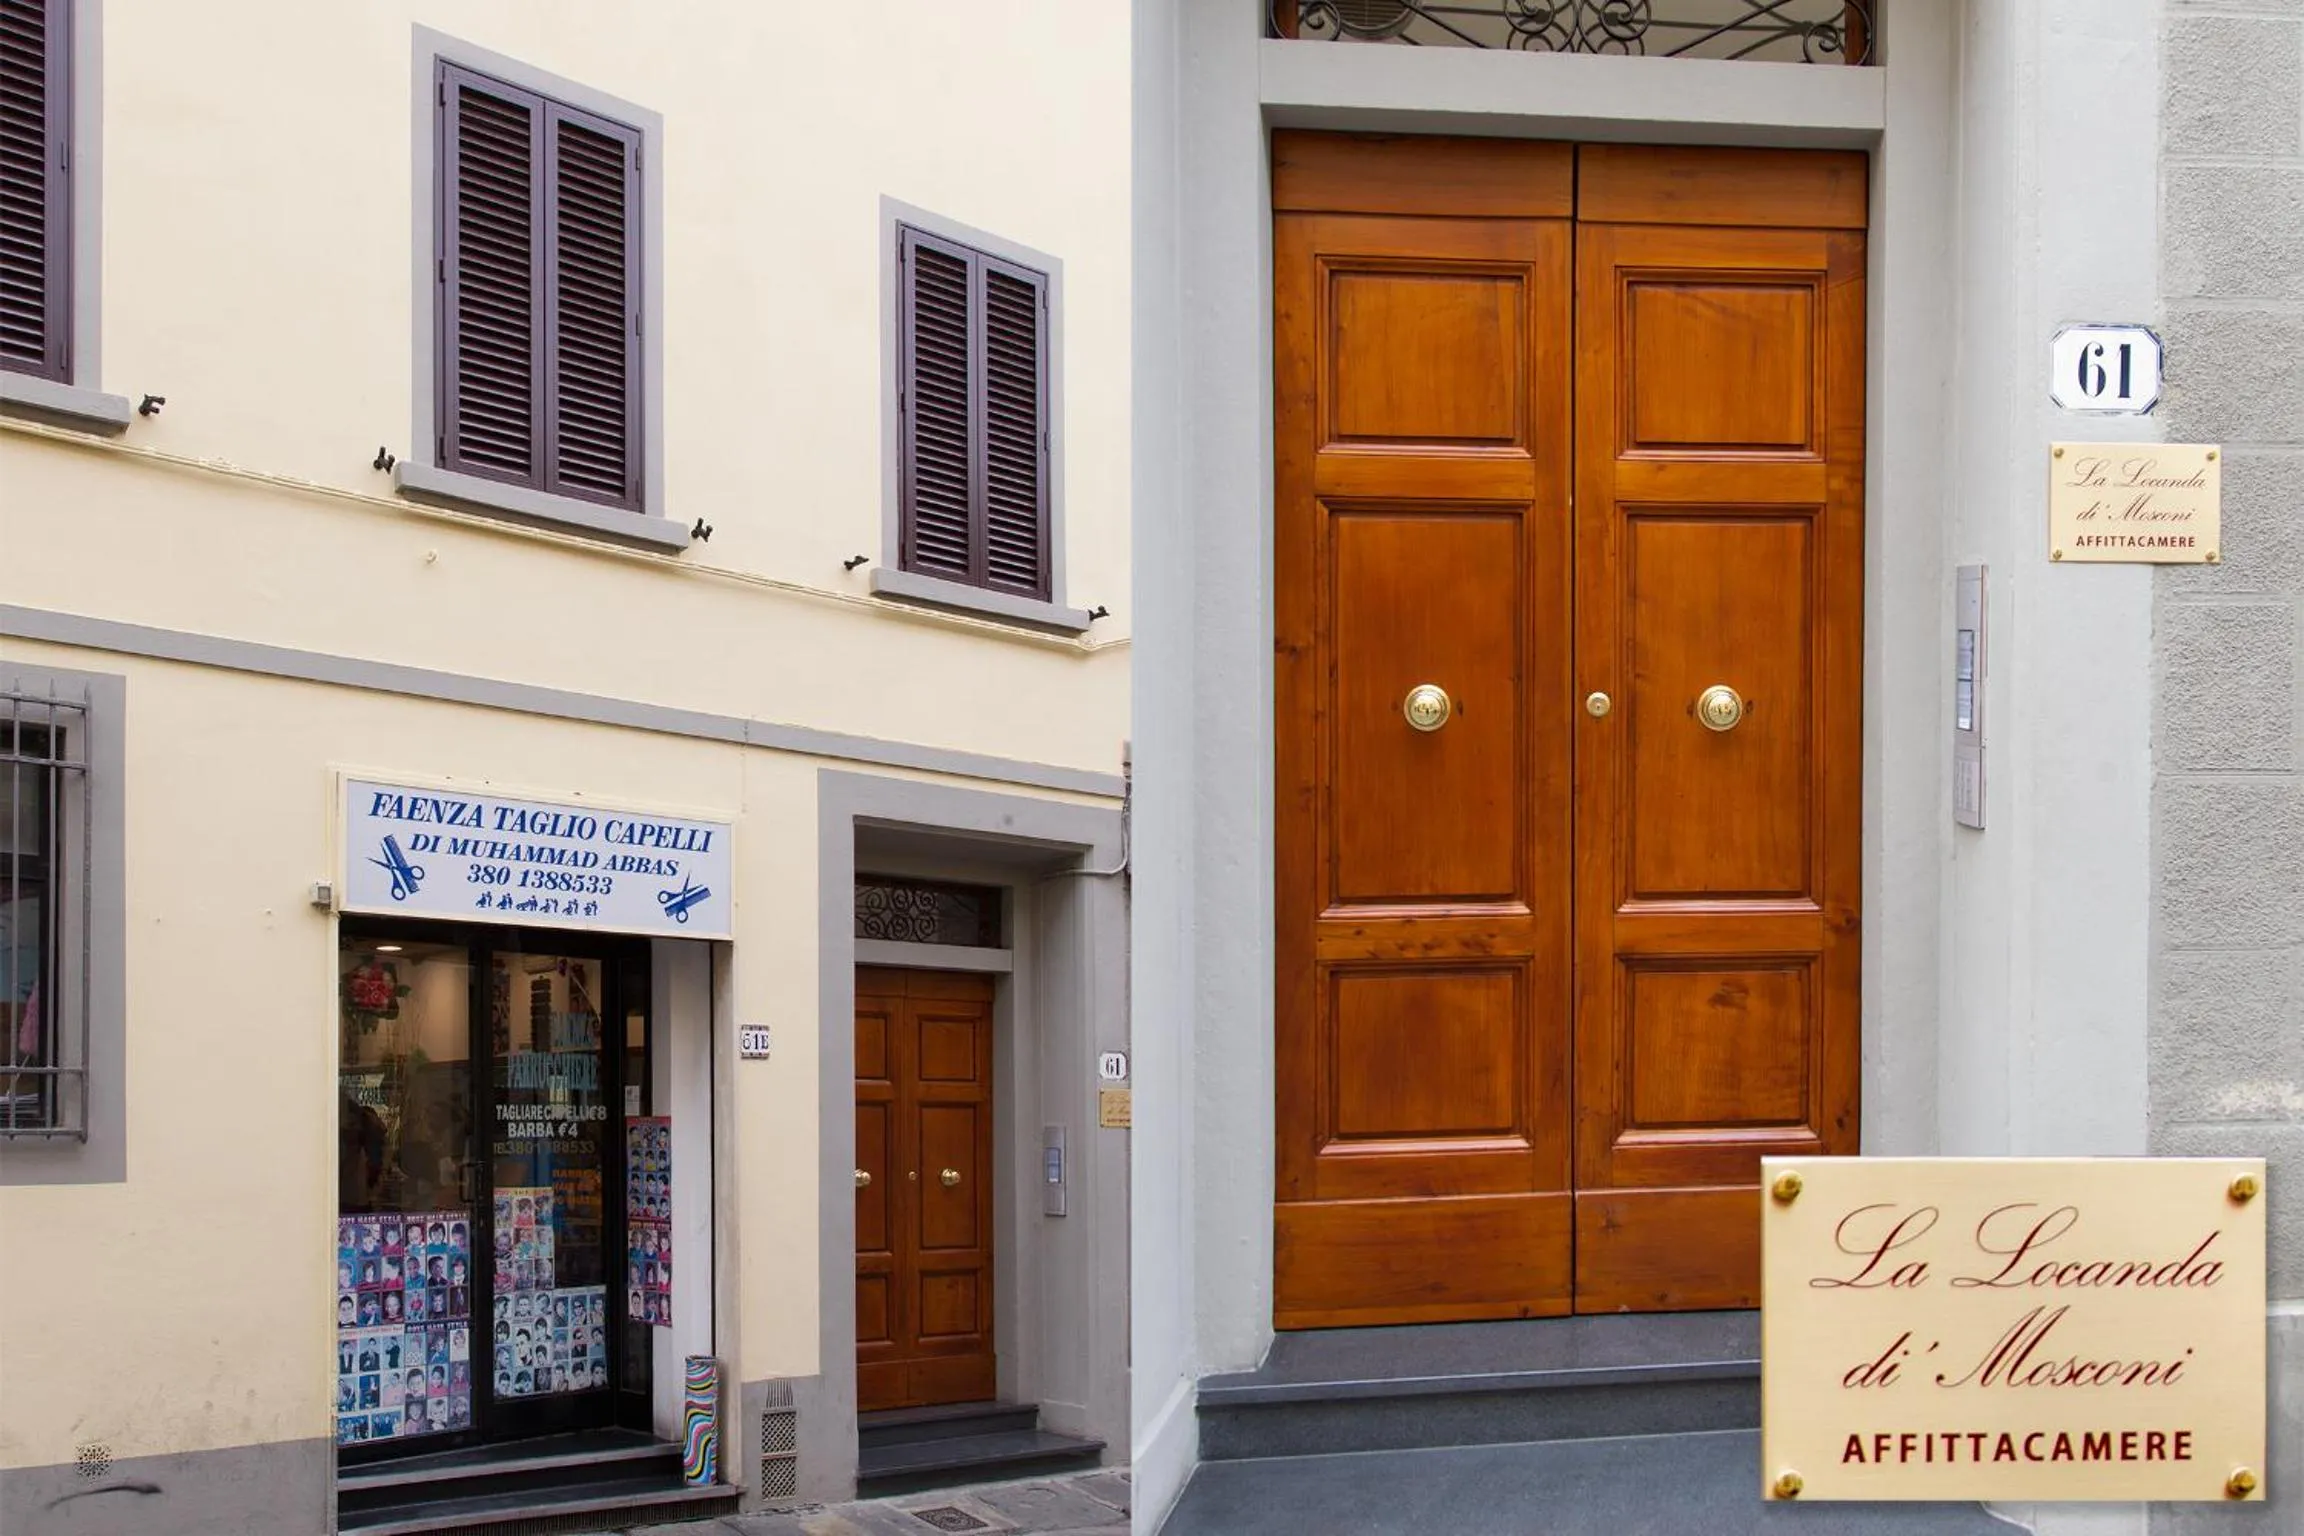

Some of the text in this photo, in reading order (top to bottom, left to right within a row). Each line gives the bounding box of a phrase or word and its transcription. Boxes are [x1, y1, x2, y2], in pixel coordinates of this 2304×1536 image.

[2078, 340, 2131, 399] 61
[2064, 457, 2207, 488] La Locanda
[2107, 492, 2196, 522] Mosconi
[2076, 535, 2196, 548] AFFITTACAMERE
[369, 792, 714, 853] FAENZA TAGLIO CAPELLI
[409, 833, 680, 876] DI MUHAMMAD ABBAS
[467, 863, 613, 895] 380 1388533
[1105, 1057, 1120, 1076] 61
[495, 1104, 543, 1120] TAGLIARE
[508, 1122, 555, 1138] BARBA
[1808, 1203, 2225, 1289] La Locanda
[1935, 1304, 2194, 1388] Mosconi
[1842, 1430, 2193, 1464] AFFITTACAMERE
